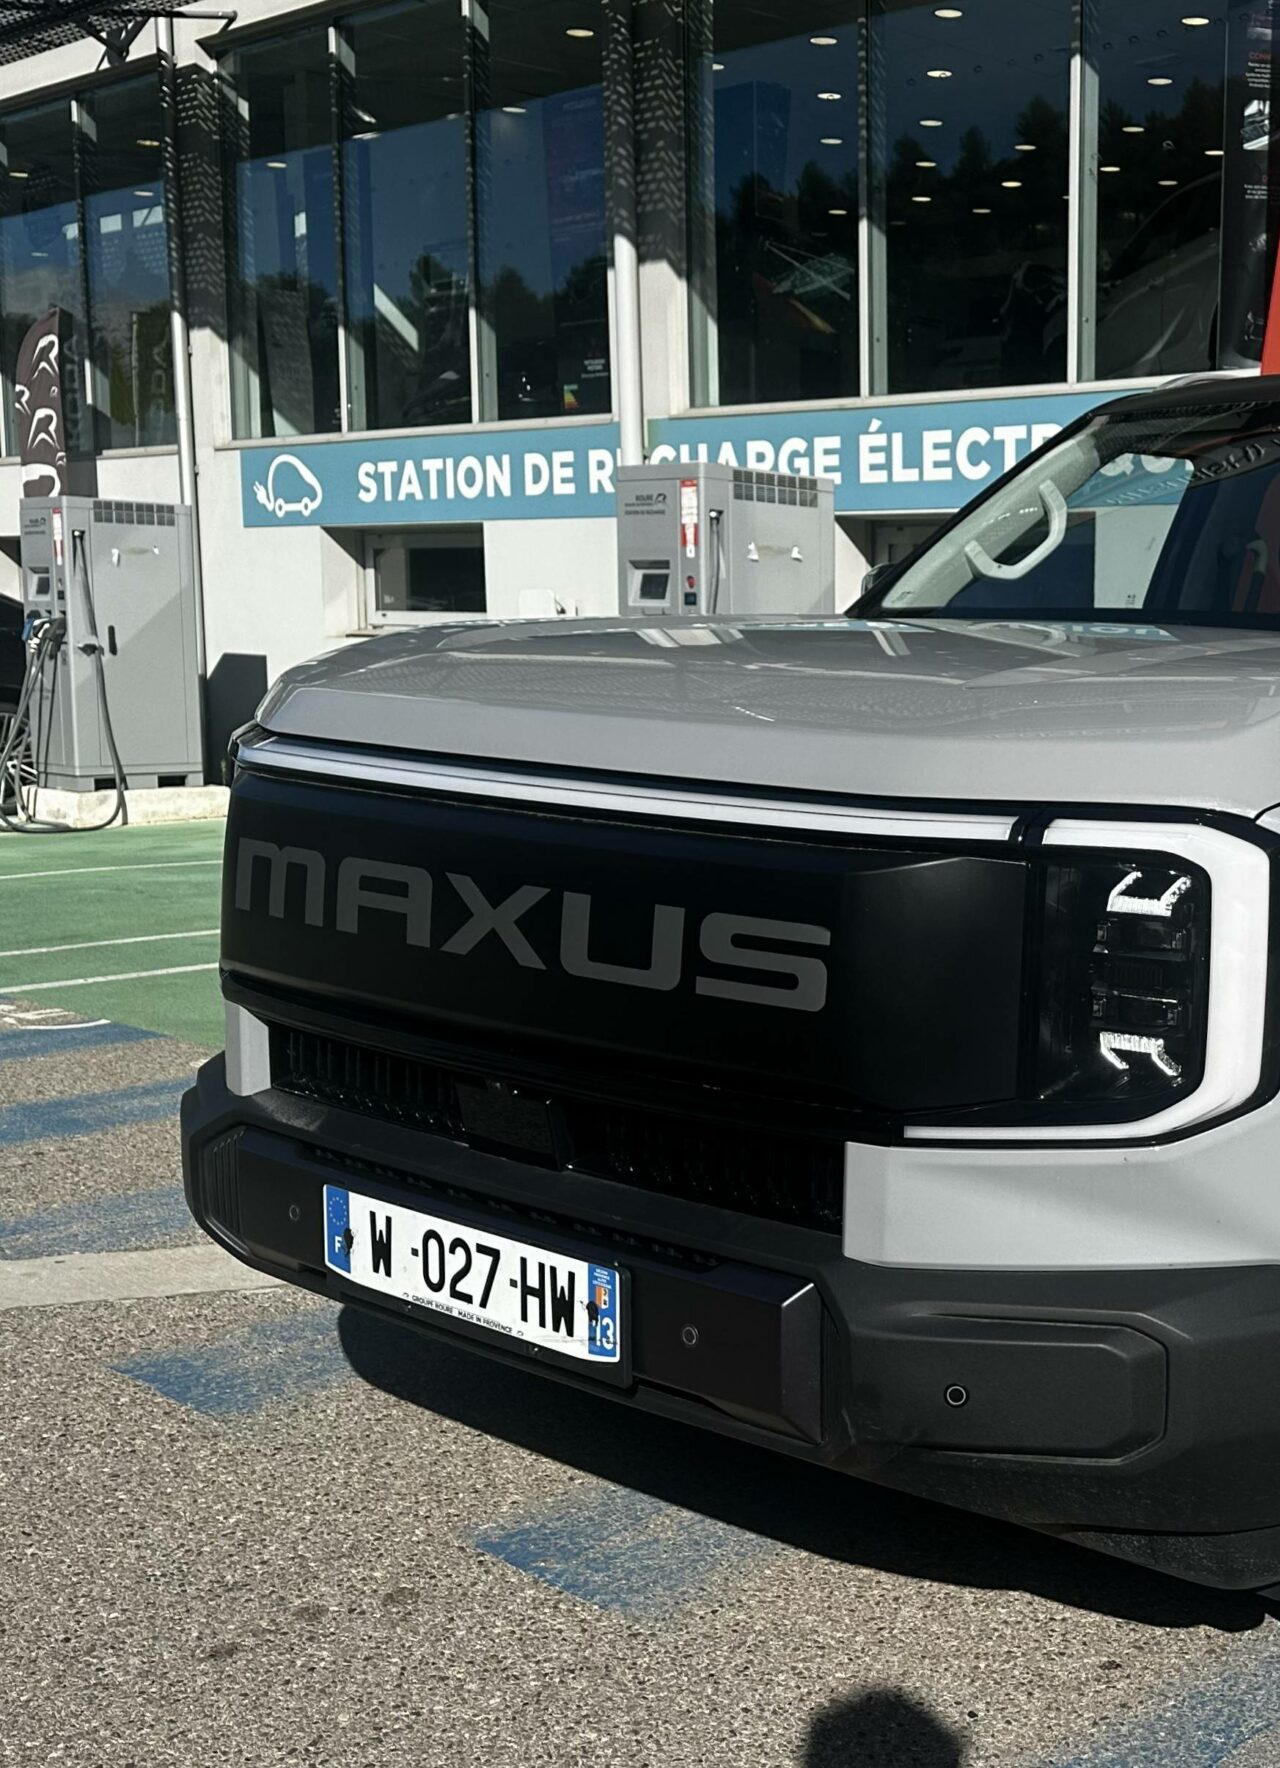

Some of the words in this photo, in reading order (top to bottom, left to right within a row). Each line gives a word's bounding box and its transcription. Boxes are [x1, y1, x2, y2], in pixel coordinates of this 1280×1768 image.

[358, 454, 511, 503] STATION
[524, 450, 576, 497] DE
[235, 837, 832, 1012] MAXUS
[335, 1236, 343, 1254] F
[457, 1309, 474, 1321] MADE
[482, 1317, 513, 1334] PROVENCE
